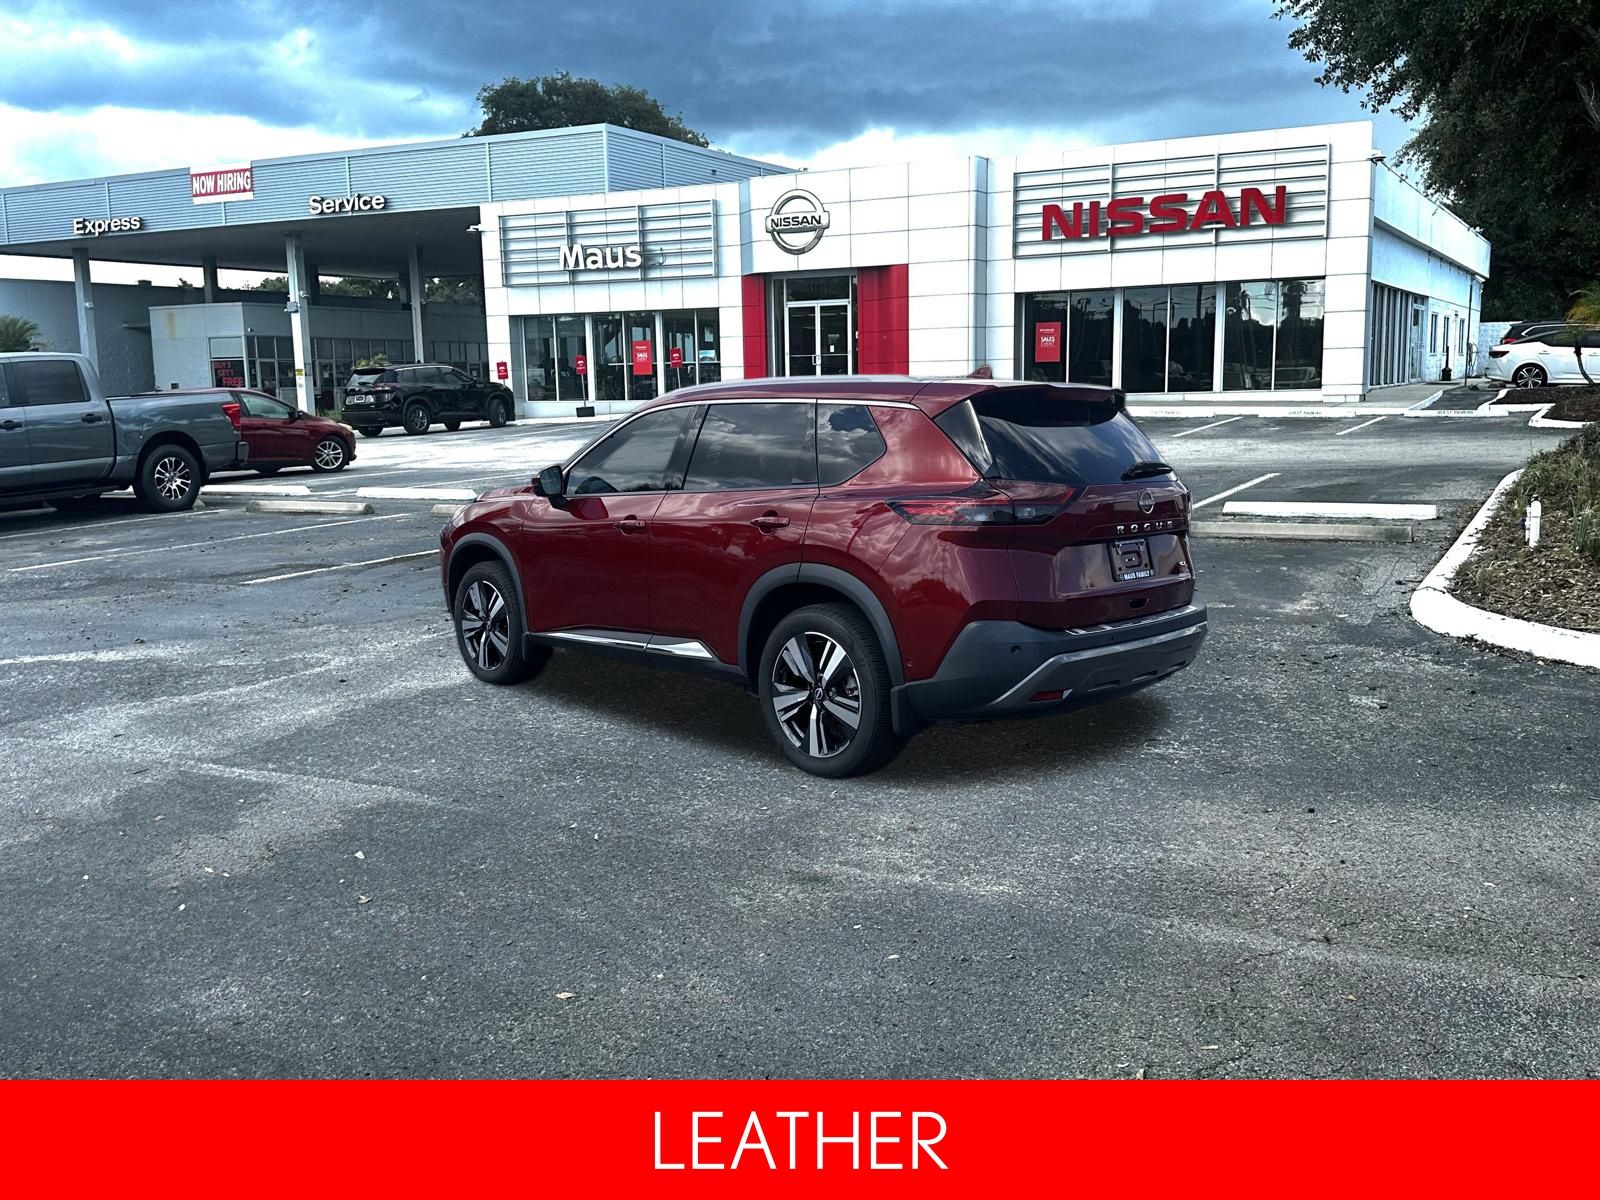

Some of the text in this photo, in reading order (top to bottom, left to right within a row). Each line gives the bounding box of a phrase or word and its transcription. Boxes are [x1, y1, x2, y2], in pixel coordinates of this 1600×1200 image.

[192, 170, 251, 195] NOW HIRING
[309, 193, 385, 215] Service
[1042, 185, 1287, 241] NISSAN
[73, 216, 141, 237] Express
[770, 215, 822, 228] NISSAN
[559, 243, 642, 270] Maus
[223, 377, 244, 387] FREE
[1117, 521, 1173, 533] ROGUE
[1124, 570, 1150, 580] MAUS FAMILY
